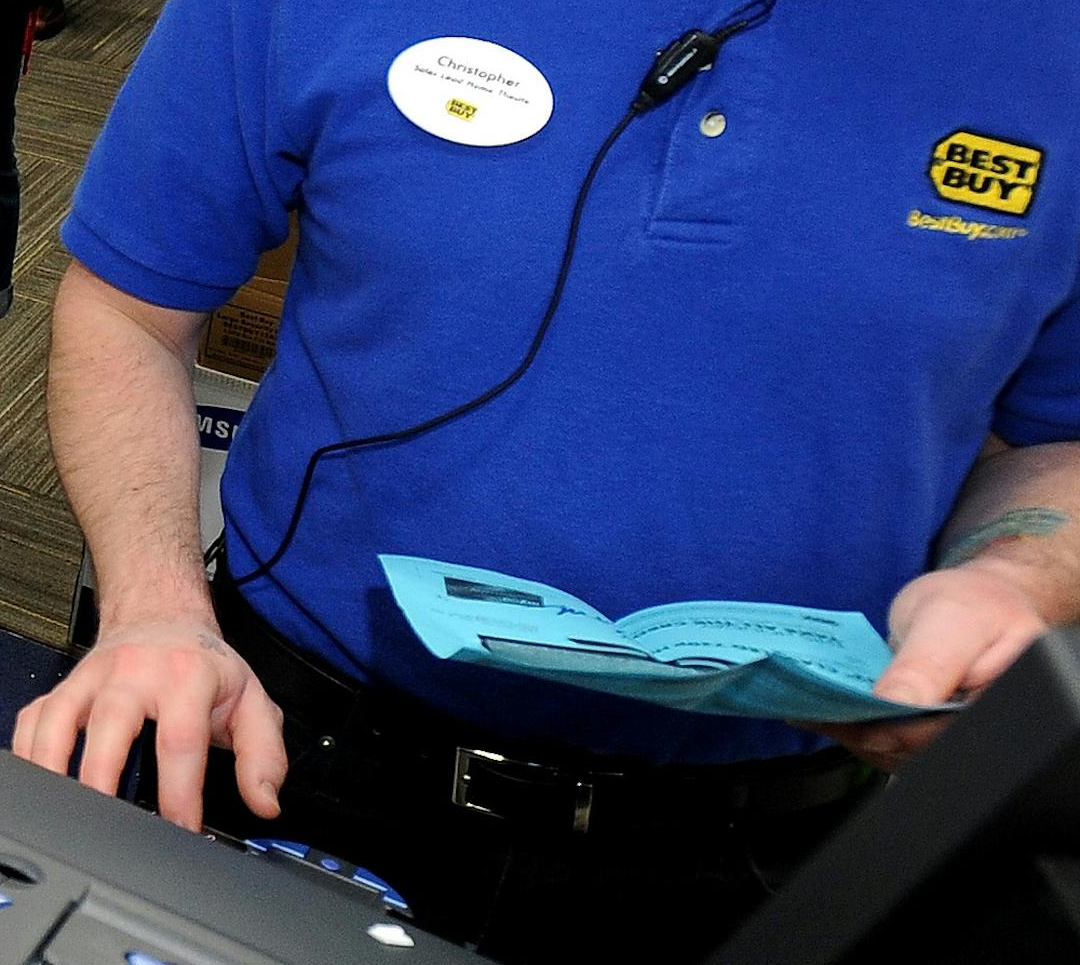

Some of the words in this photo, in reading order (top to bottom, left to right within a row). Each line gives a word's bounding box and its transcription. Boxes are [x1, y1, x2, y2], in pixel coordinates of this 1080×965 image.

[436, 55, 521, 88] Christopher
[448, 105, 473, 120] BUY
[450, 98, 478, 116] BEST
[946, 142, 1035, 179] BEST
[942, 166, 1020, 201] BUY
